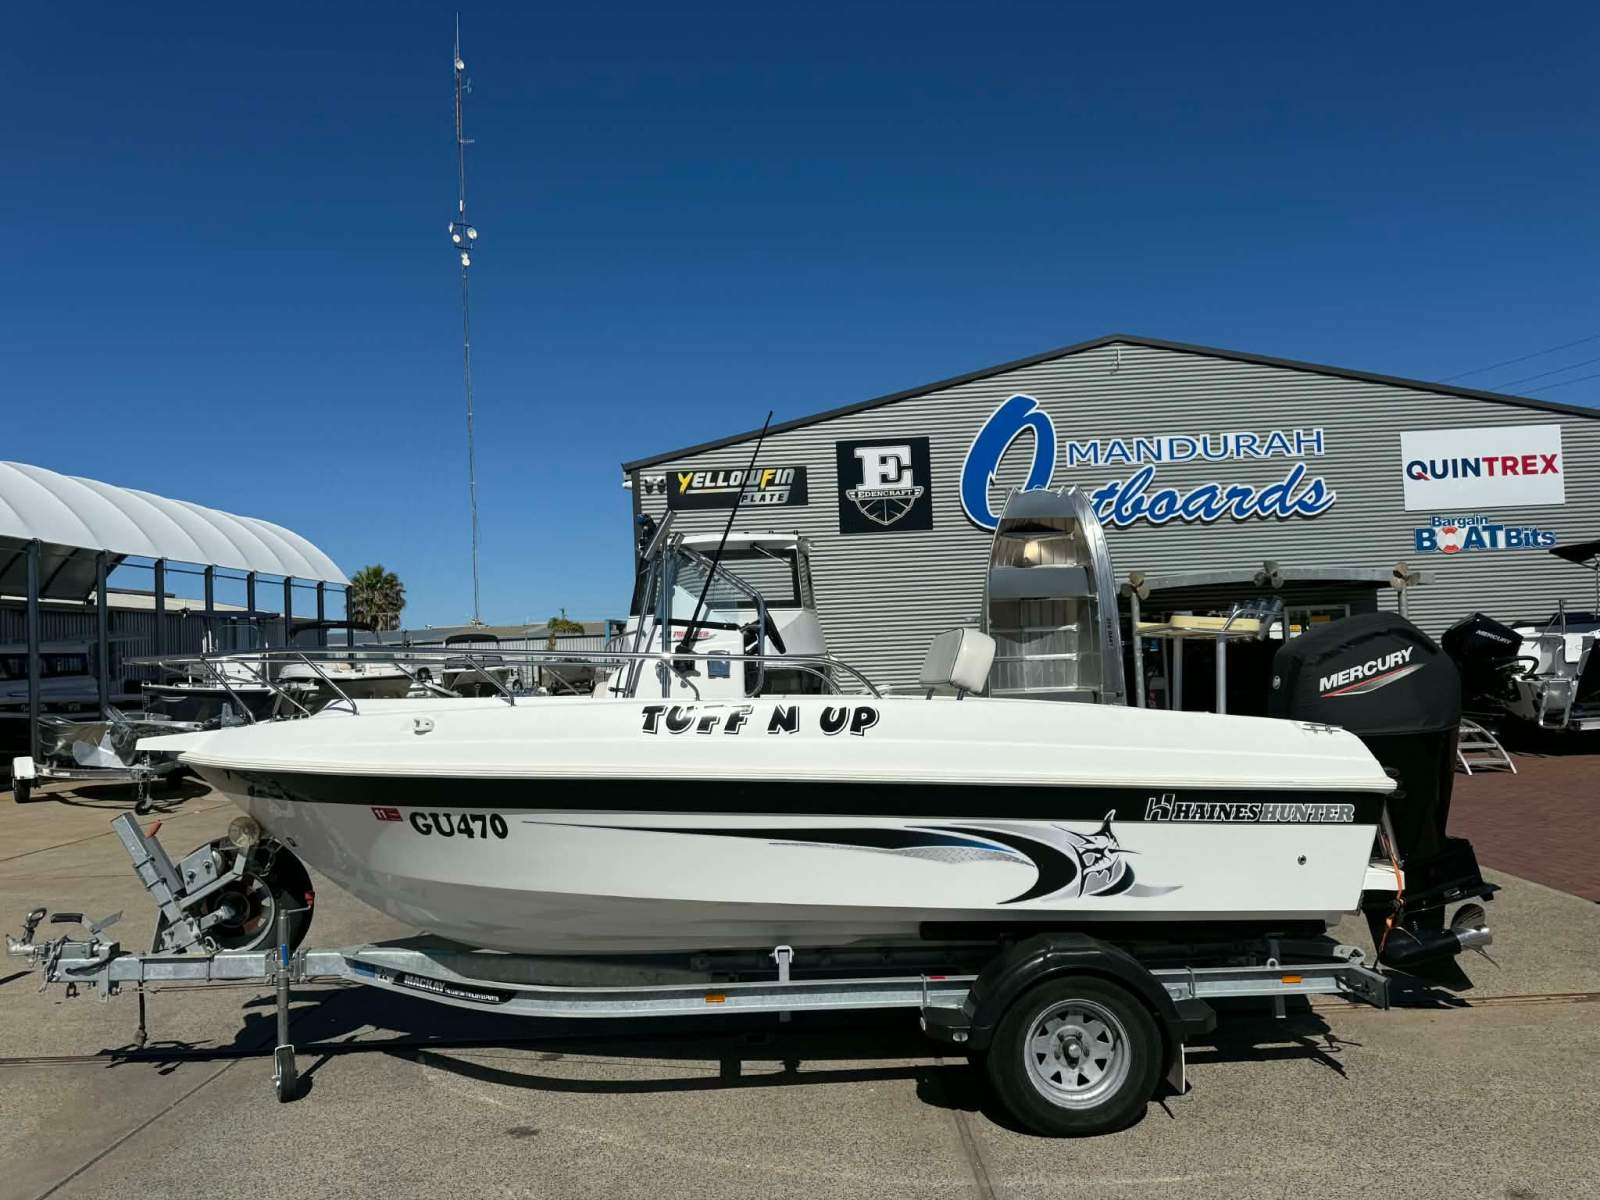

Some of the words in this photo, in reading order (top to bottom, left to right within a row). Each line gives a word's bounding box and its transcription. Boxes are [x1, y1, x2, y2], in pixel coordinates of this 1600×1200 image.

[960, 394, 1336, 530] Otboards
[1066, 427, 1325, 469] MANDURAH
[854, 445, 913, 490] E
[1406, 454, 1560, 481] QUINTREX
[741, 493, 785, 503] PLATE
[857, 489, 913, 498] EDENCRAFT
[1431, 514, 1489, 529] Bargain
[1476, 630, 1512, 645] MERCURY
[1320, 646, 1413, 692] MERCURY
[642, 704, 753, 735] TUFF
[767, 704, 800, 734] N
[819, 705, 880, 736] UP
[409, 811, 509, 839] GU470
